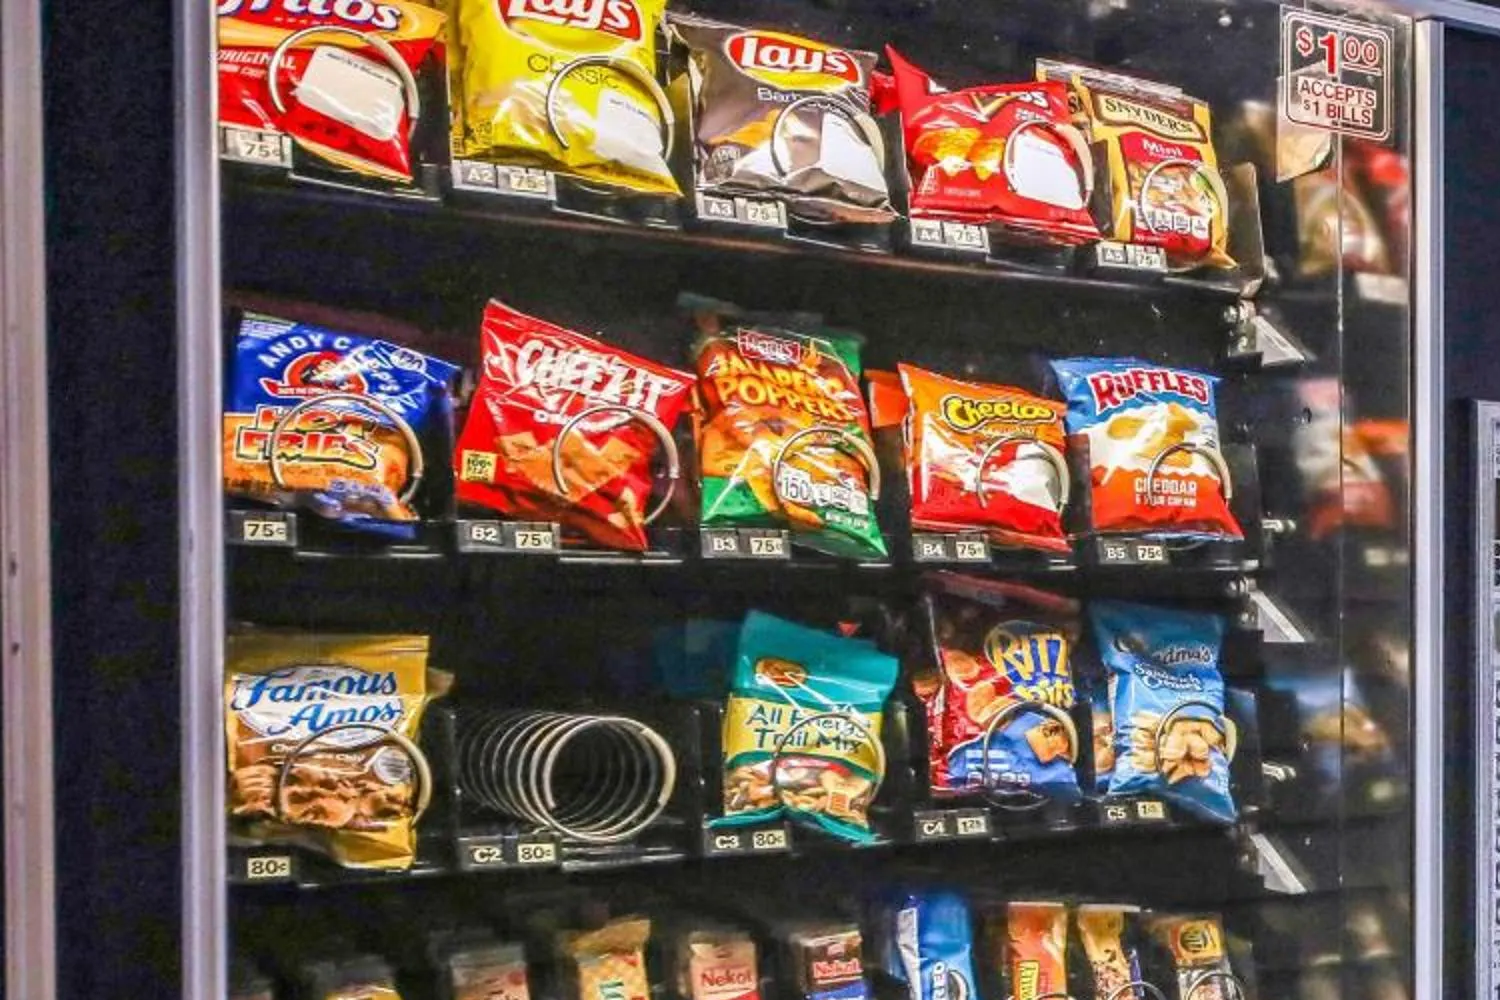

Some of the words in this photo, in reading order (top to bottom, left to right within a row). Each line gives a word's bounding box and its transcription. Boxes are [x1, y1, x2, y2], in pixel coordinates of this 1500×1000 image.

[1300, 79, 1376, 107] ACCEPTS
[1326, 103, 1372, 126] BILLS
[258, 333, 324, 369] ANDY
[714, 376, 858, 422] POPPERS
[1088, 367, 1210, 414] RUFFLES
[943, 398, 1055, 432] Cheetos
[231, 670, 398, 711] Famous
[267, 697, 405, 734] Amos
[744, 703, 783, 726] All
[752, 727, 809, 750] Trail
